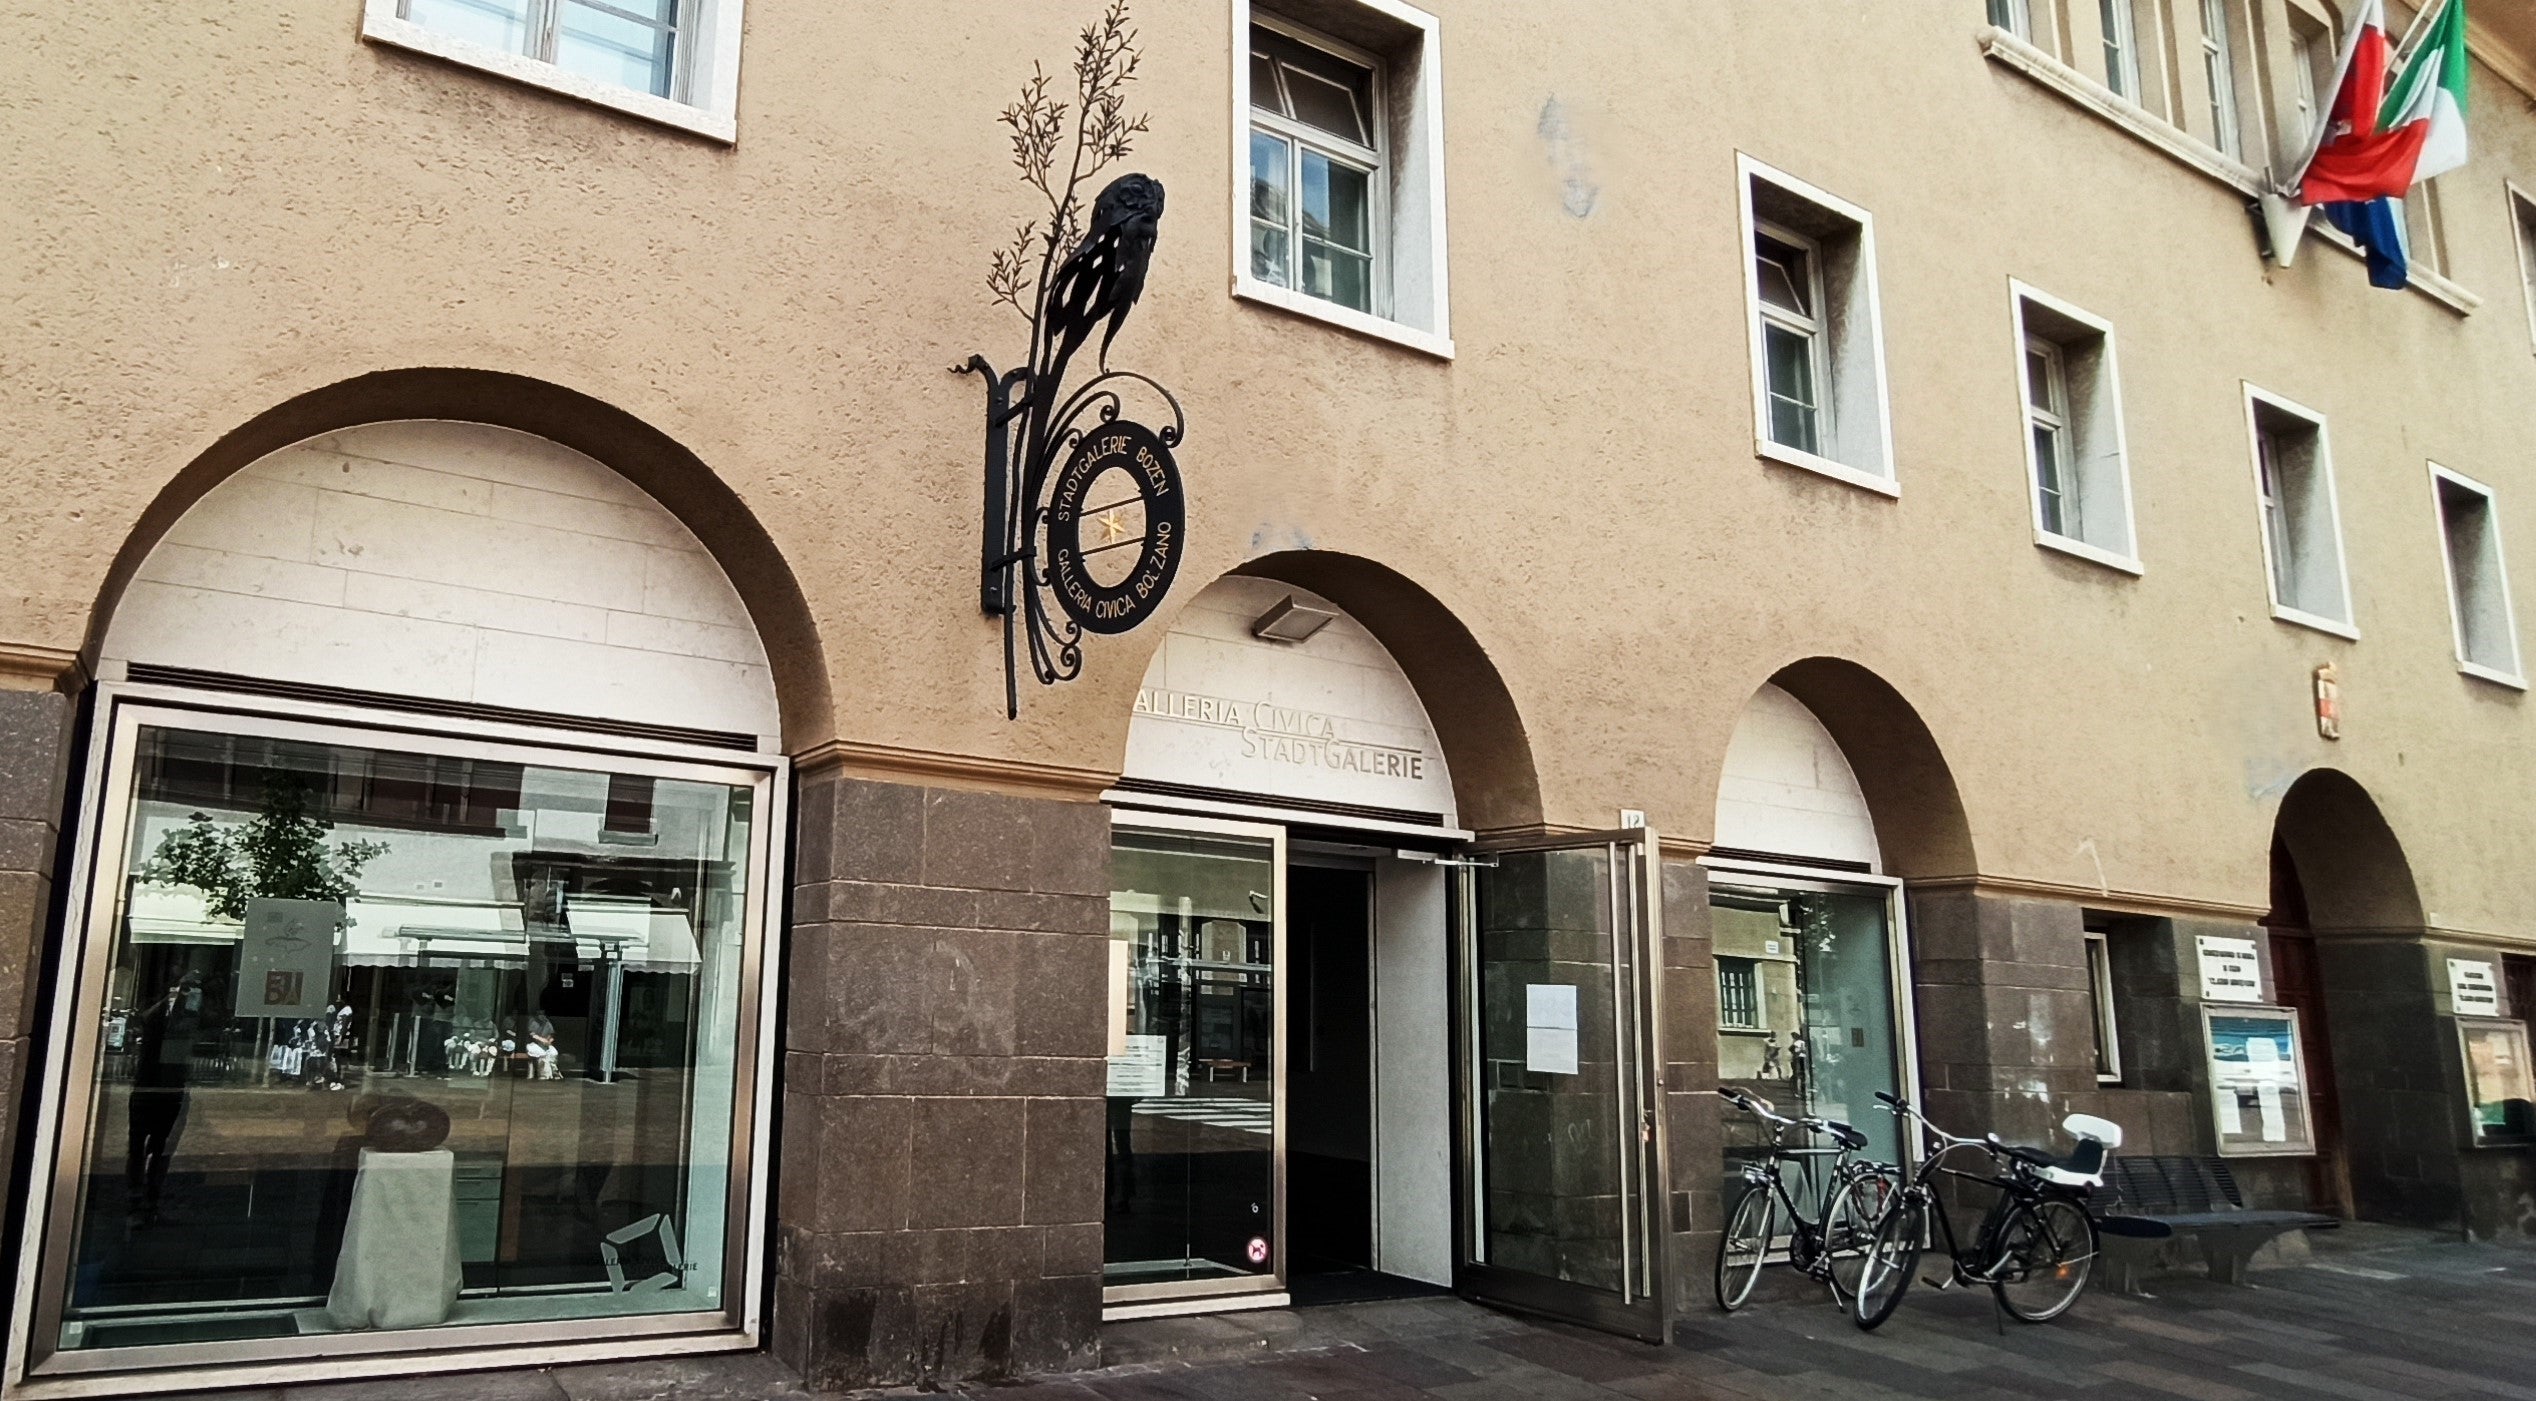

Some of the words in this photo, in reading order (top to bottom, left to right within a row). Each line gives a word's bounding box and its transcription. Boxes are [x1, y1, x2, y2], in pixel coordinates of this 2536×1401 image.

[1058, 435, 1132, 522] STADTGALERIE
[1135, 446, 1169, 497] BOZEN
[1057, 548, 1092, 613] GALLERIA
[1095, 594, 1136, 619] CIVICA
[1132, 688, 1240, 726] ALLERIA
[1253, 700, 1336, 739] CIVICA
[1241, 726, 1423, 780] STADTGALERIE
